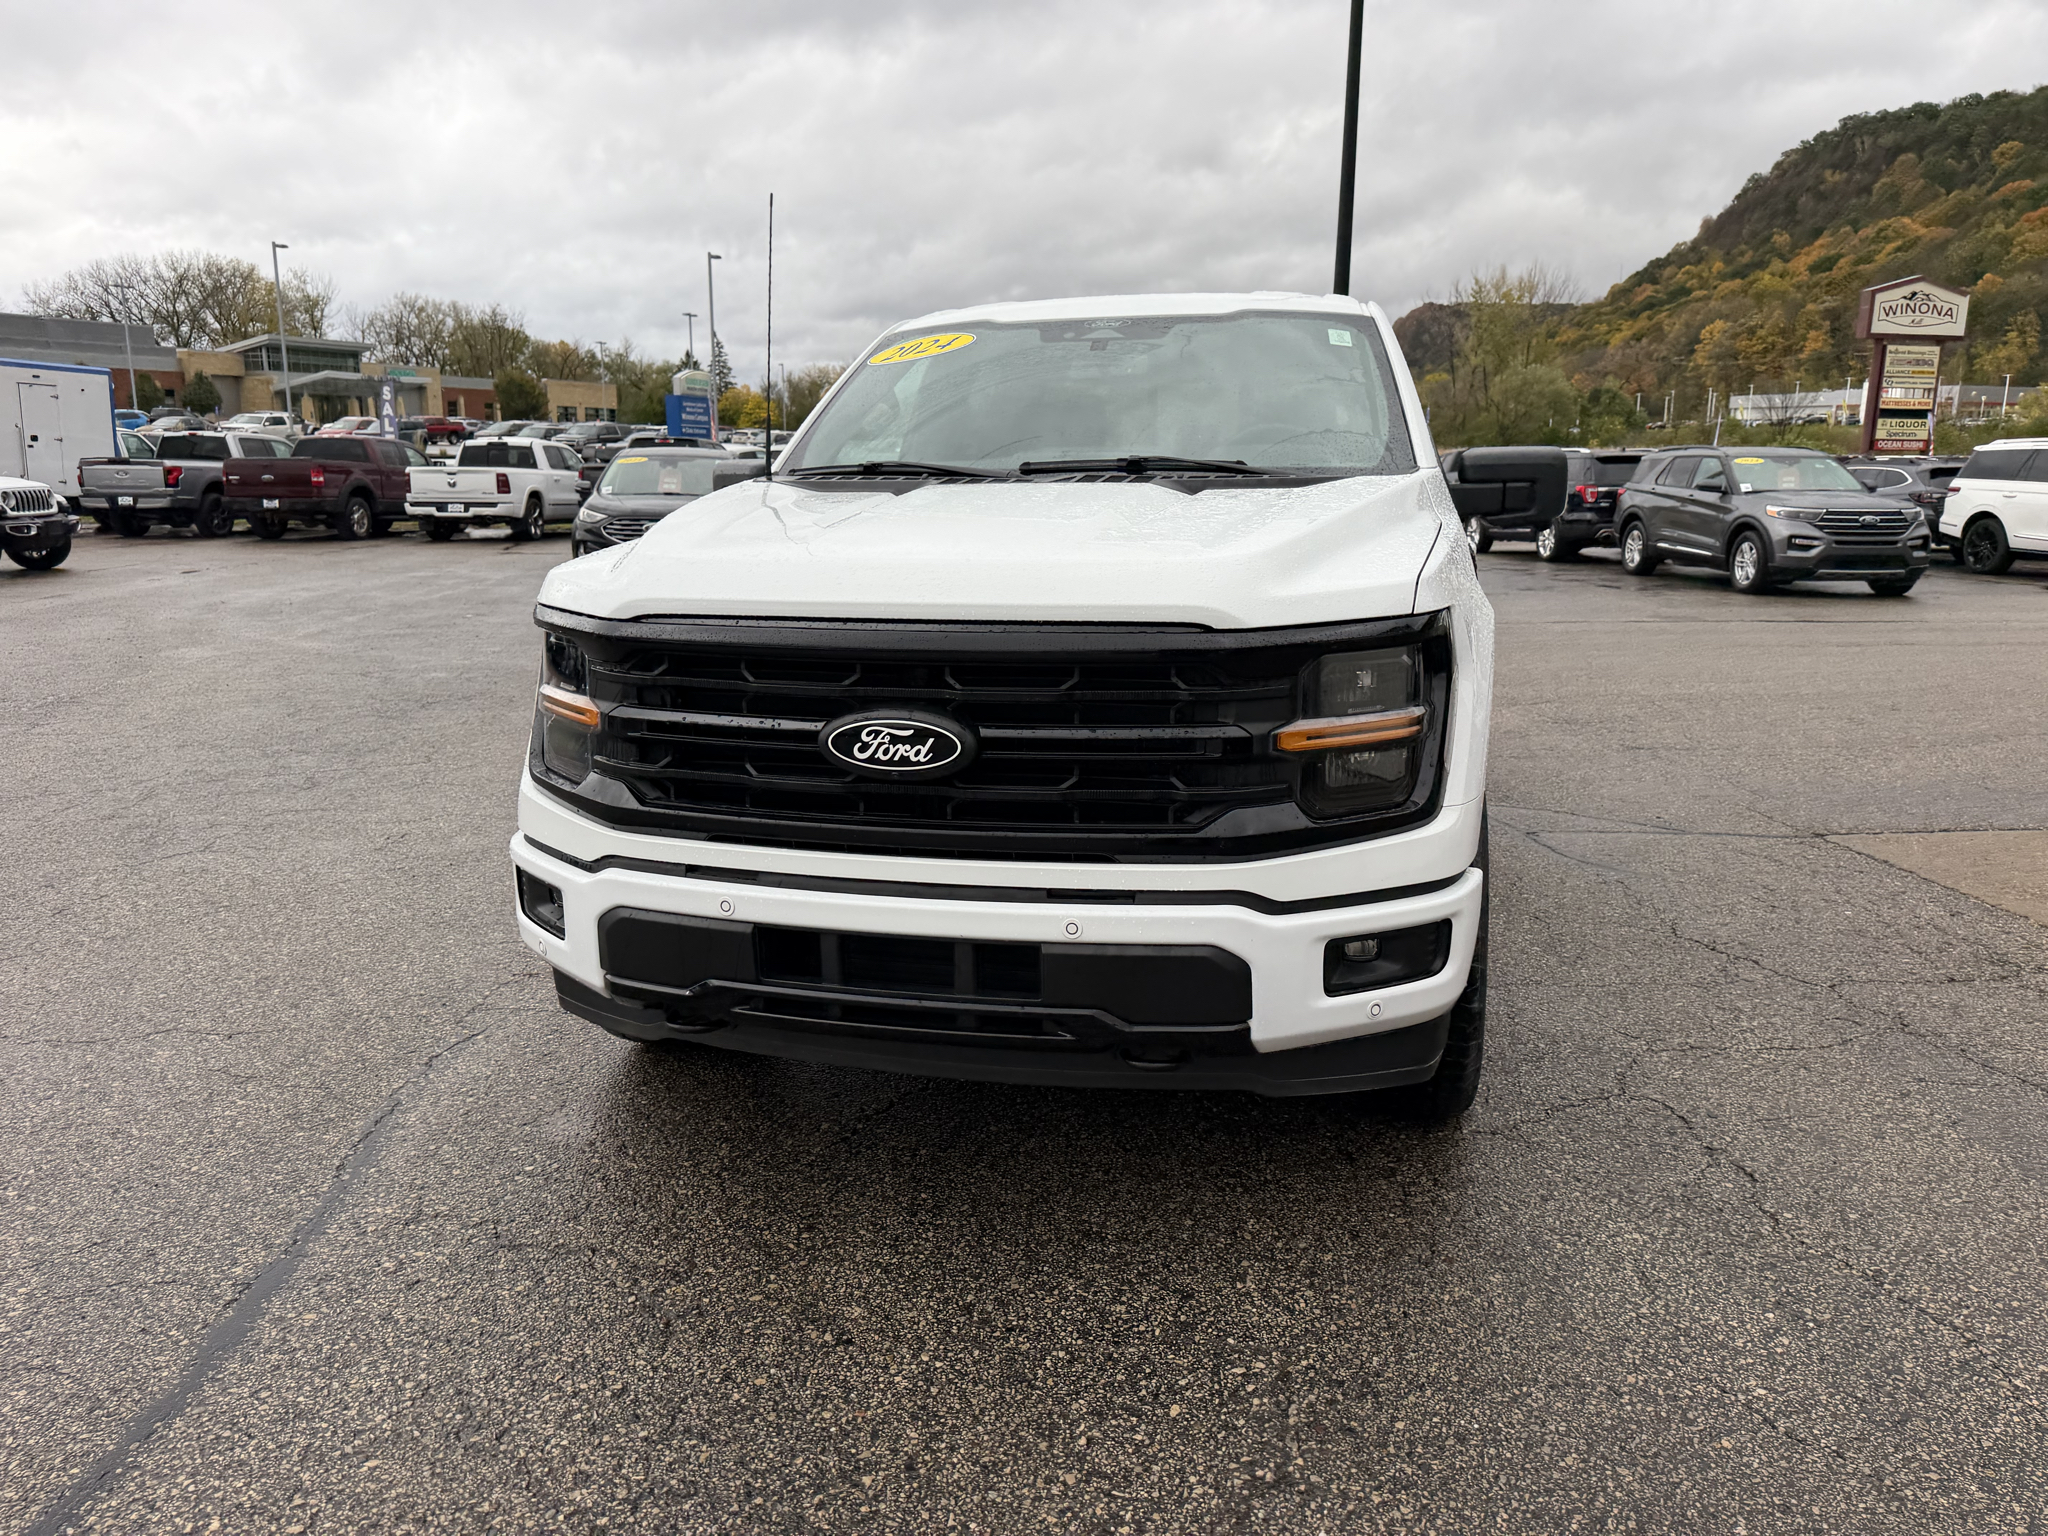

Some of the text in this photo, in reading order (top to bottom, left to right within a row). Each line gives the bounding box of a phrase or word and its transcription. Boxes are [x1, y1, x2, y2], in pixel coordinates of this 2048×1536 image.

[1882, 302, 1954, 320] WINONA
[880, 335, 962, 362] 2024
[1890, 420, 1927, 428] LIQUOR
[1877, 440, 1902, 448] OCEAN
[853, 726, 935, 762] Ford
